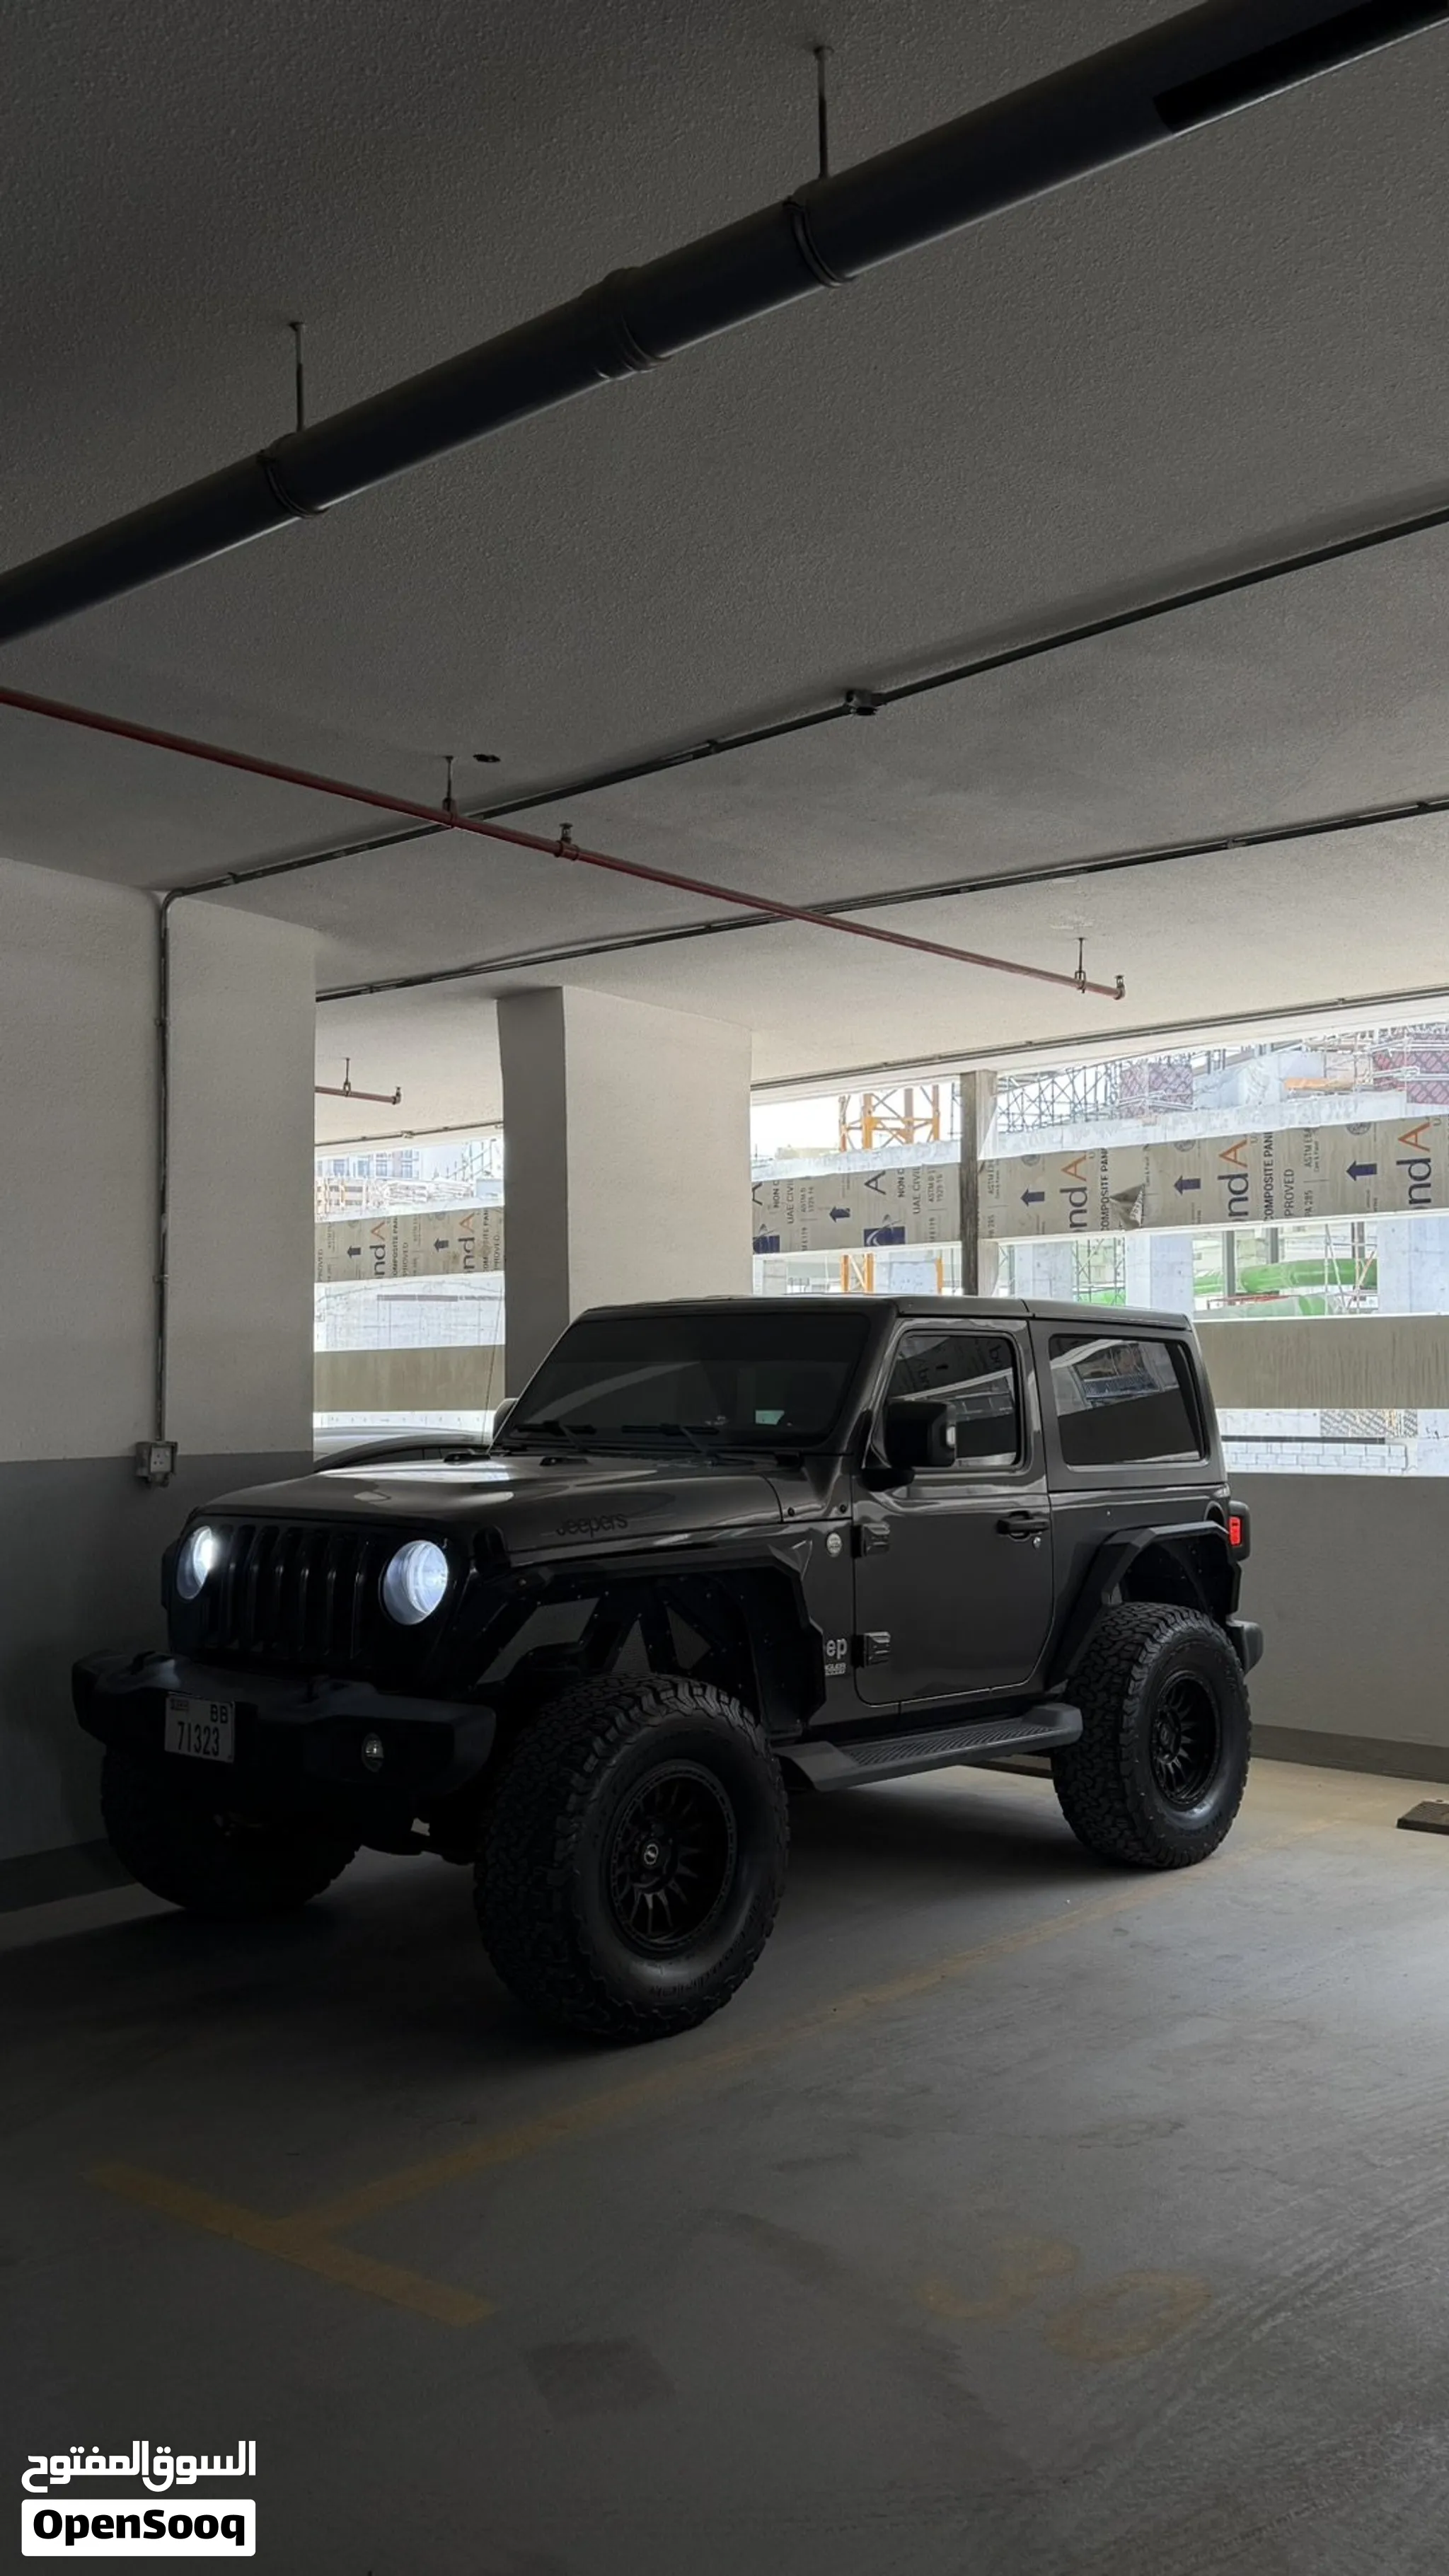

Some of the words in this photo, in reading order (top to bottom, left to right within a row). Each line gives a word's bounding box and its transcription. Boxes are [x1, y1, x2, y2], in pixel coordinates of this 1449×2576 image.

[1217, 1139, 1249, 1222] ndA
[1303, 1144, 1312, 1168] ASTM
[1396, 1121, 1432, 1210] ndA
[1058, 1153, 1088, 1233] ndA
[369, 1221, 386, 1279] ndA
[458, 1212, 475, 1273] ndA
[177, 1721, 220, 1757] 71323
[210, 1704, 229, 1724] BB
